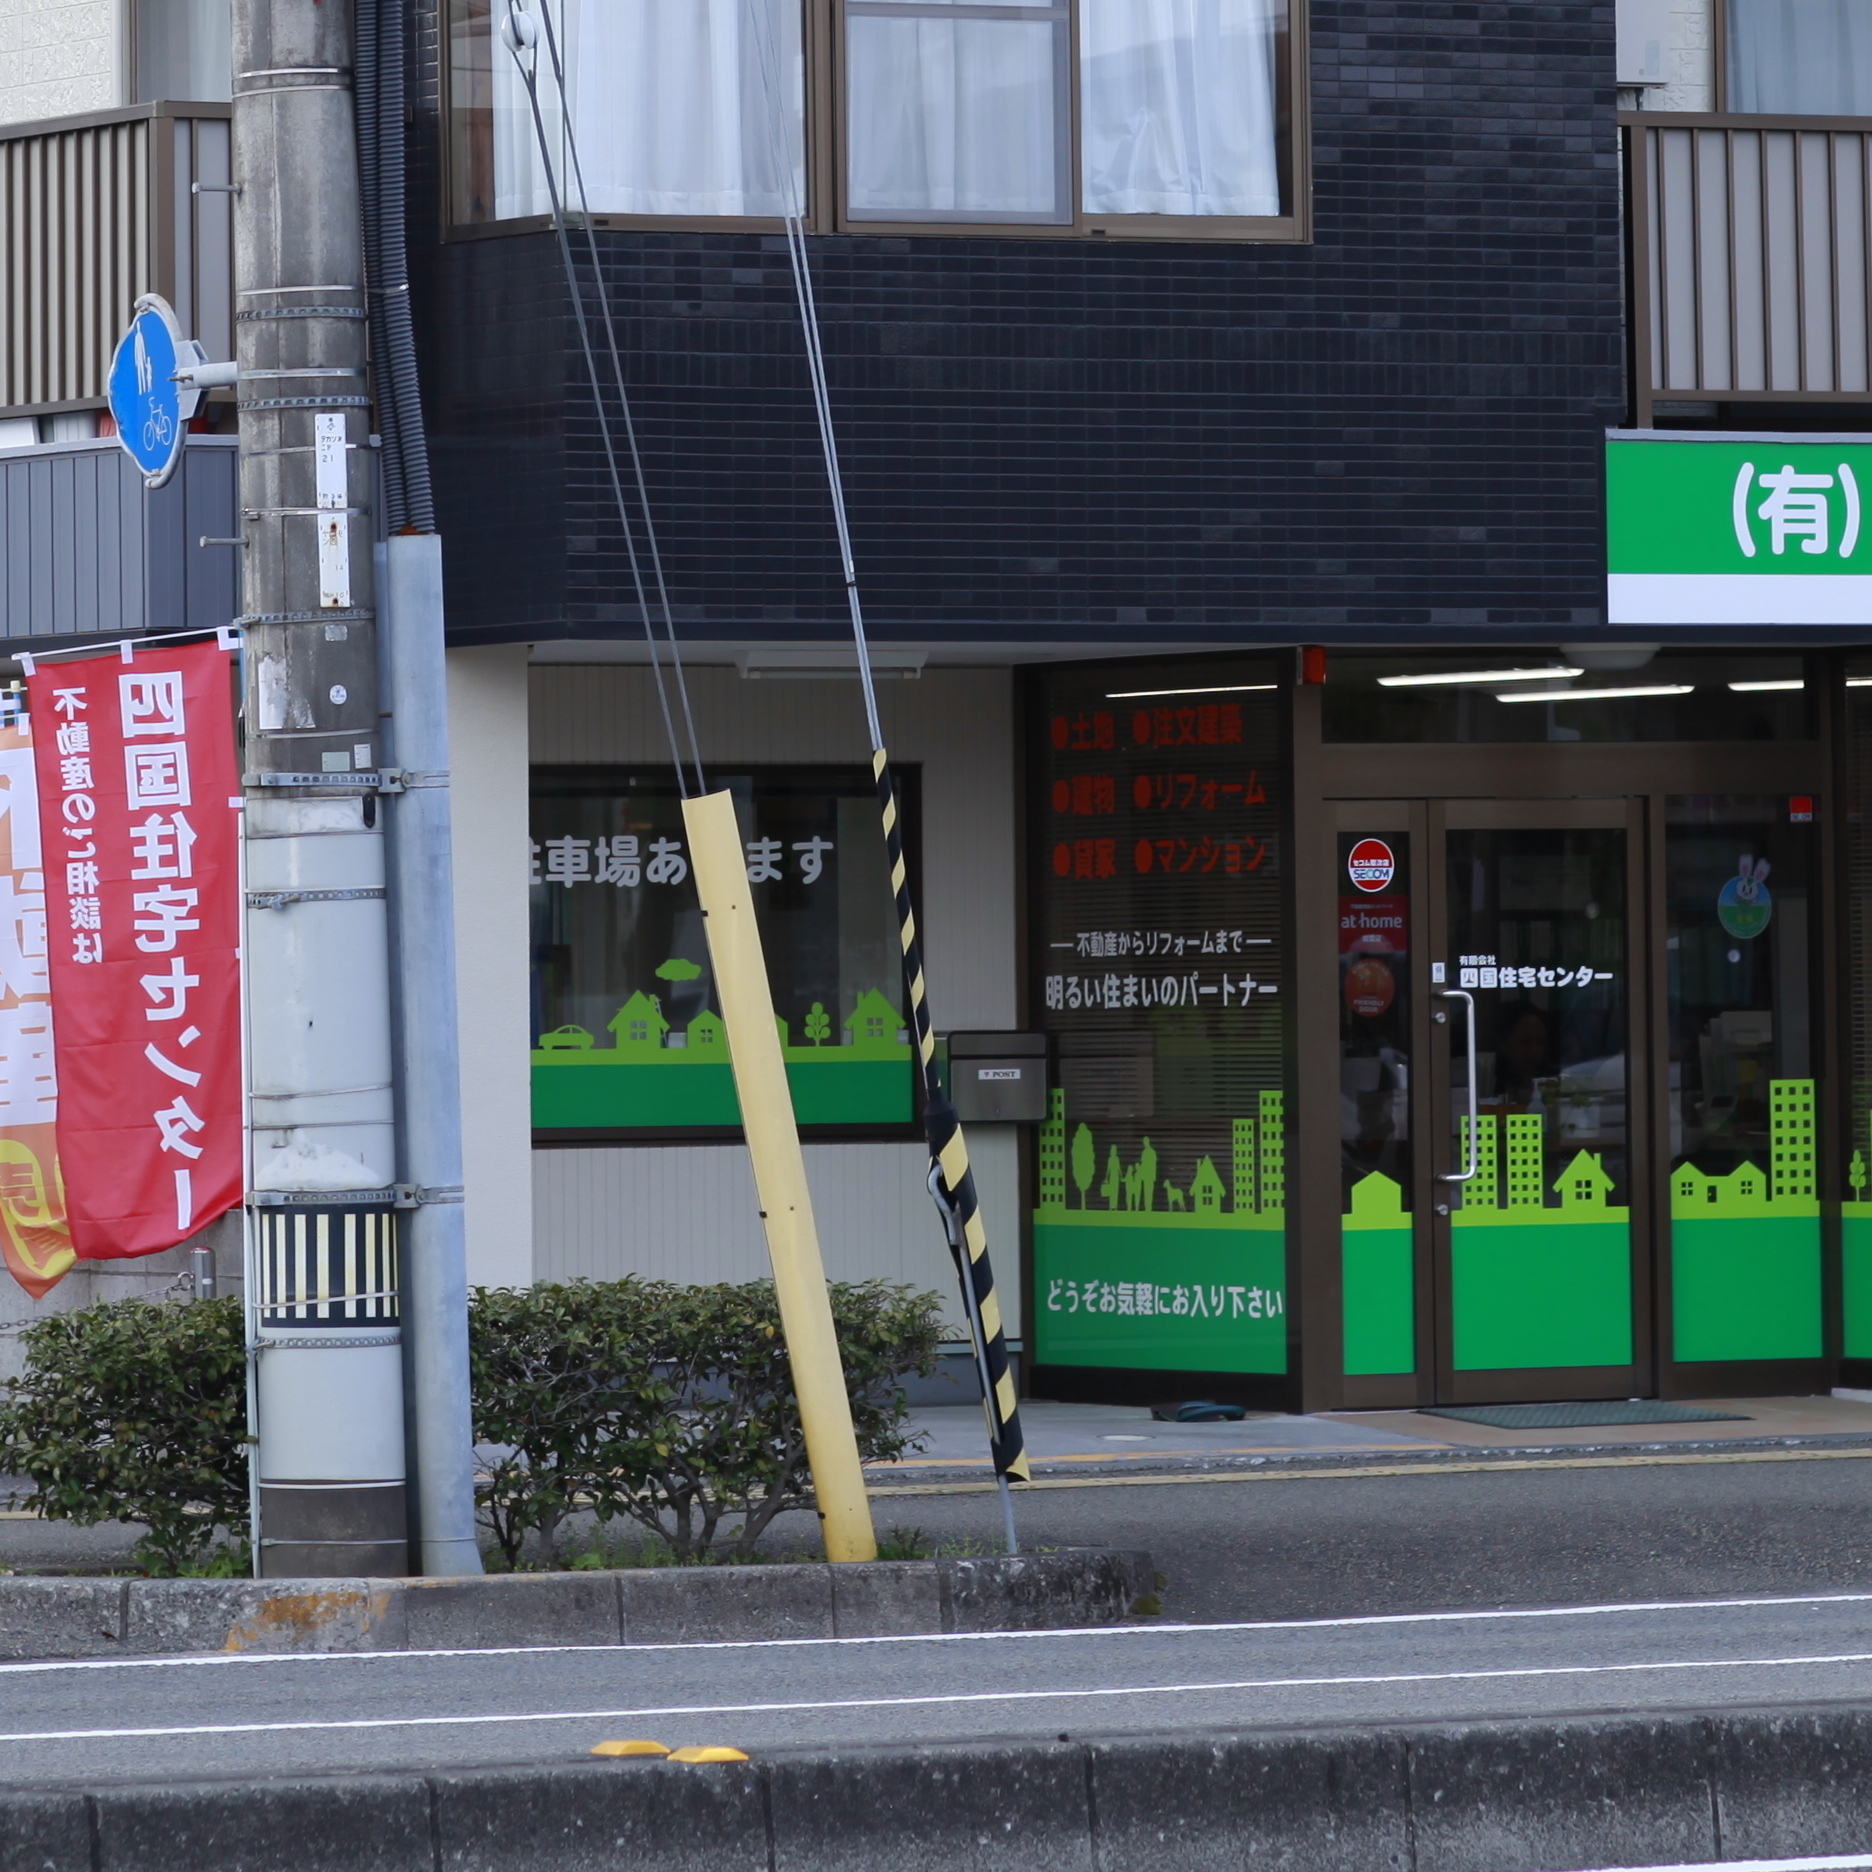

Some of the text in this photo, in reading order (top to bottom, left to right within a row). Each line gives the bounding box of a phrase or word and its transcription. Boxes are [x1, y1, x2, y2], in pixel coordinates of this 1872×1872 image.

[1156, 769, 1266, 810] リフォーム
[529, 835, 834, 888] 車場あます
[1155, 836, 1267, 874] マンション
[1353, 869, 1390, 880] SECOM
[1341, 912, 1403, 928] at home
[1077, 930, 1243, 958] 不動産からリフォームまで
[1045, 971, 1278, 1010] 明るい住まいのパートナー
[1460, 966, 1614, 989] 四国住宅センター
[1047, 1278, 1283, 1320] どうぞお気軽にお入り下さい
